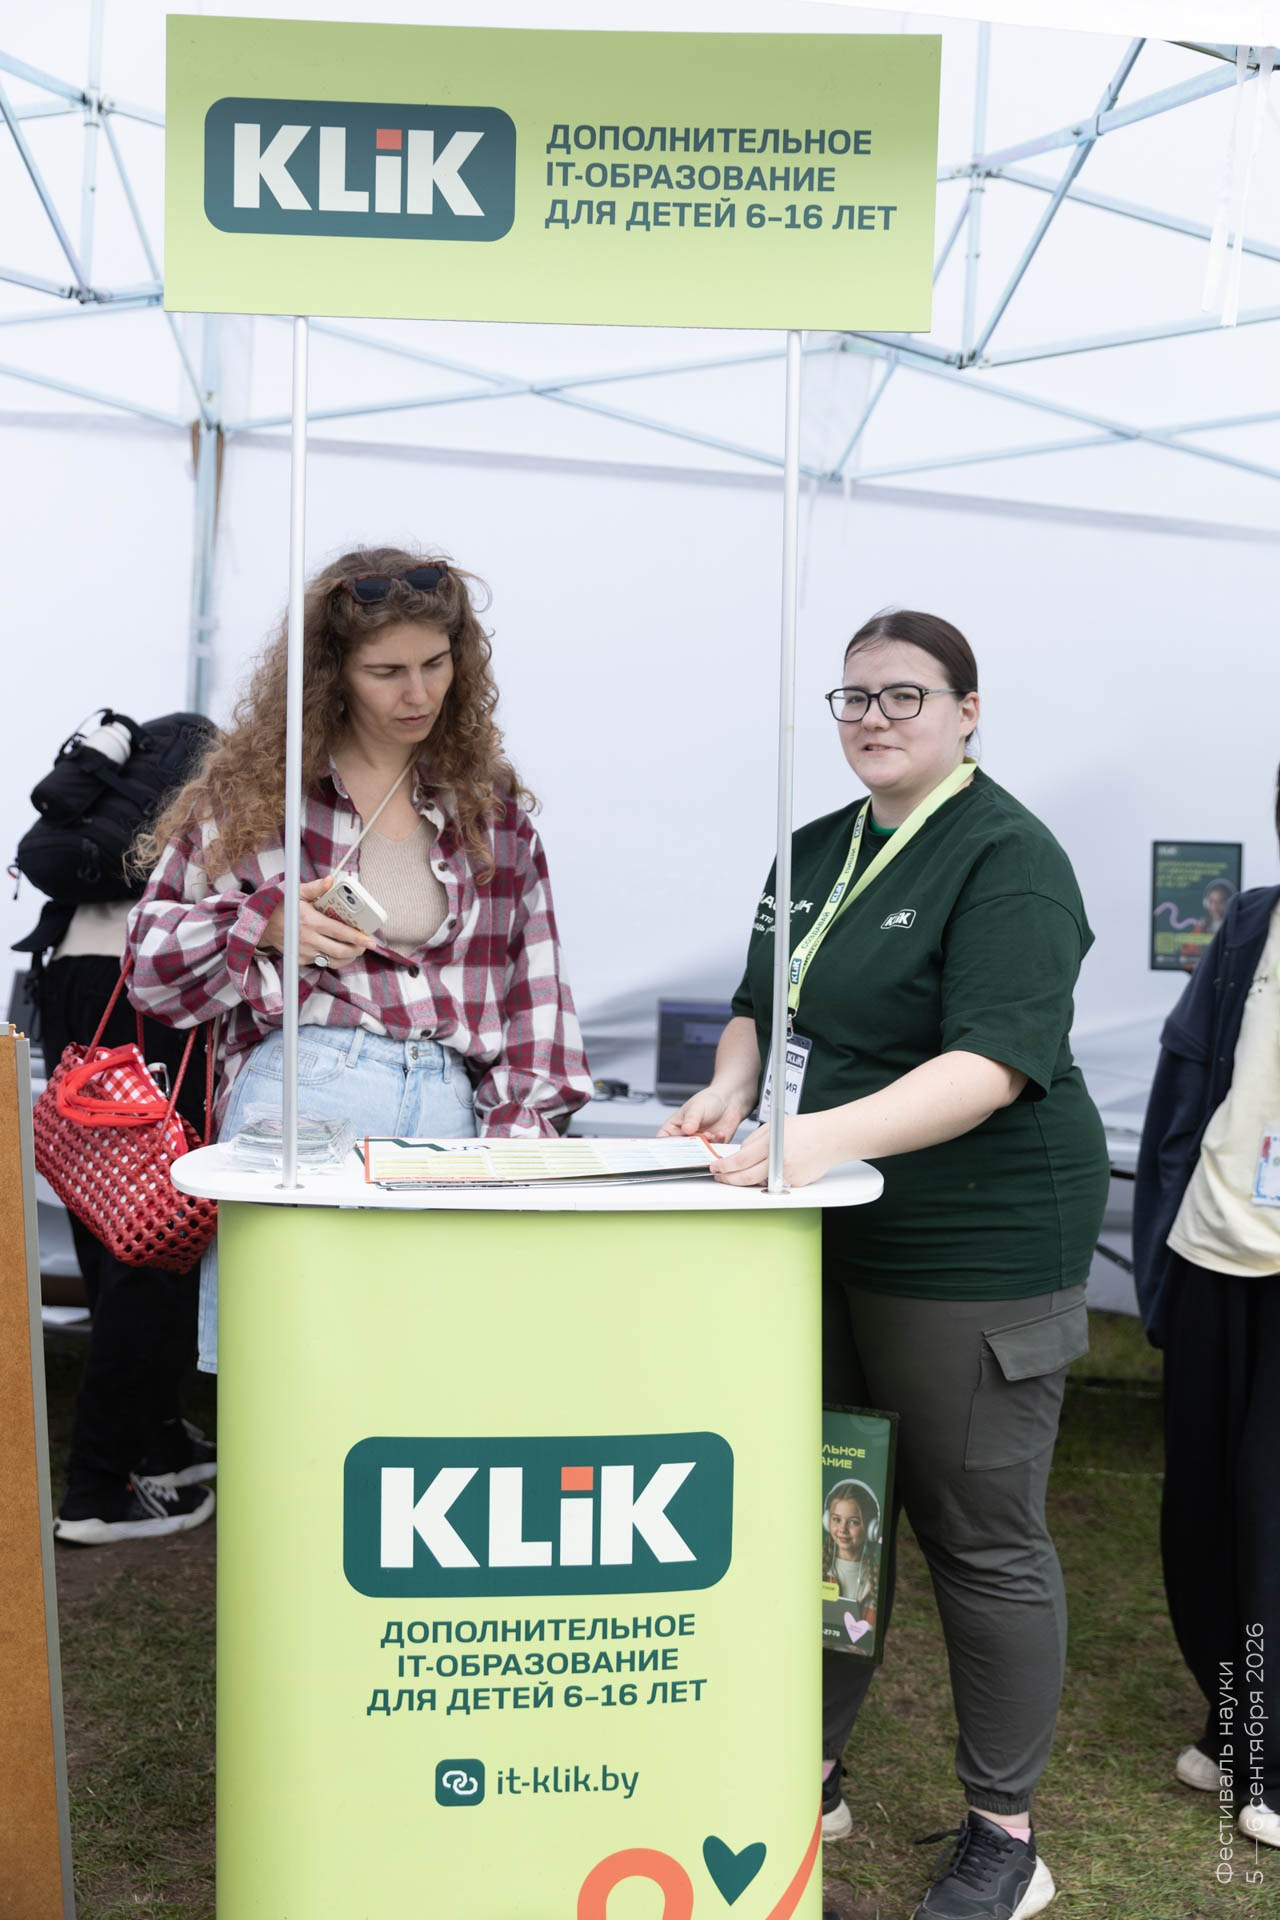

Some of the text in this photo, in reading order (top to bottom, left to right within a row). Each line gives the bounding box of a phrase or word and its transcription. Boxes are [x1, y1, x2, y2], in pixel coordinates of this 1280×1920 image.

[546, 124, 872, 155] ДОПОЛНИТЕЛЬНОЕ
[232, 122, 485, 218] KLiK
[546, 161, 836, 192] IT-ОБРАЗОВАНИЕ
[545, 197, 898, 232] ДЛЯ ДЕТЕЙ 6–16 ЛЕТ
[791, 959, 802, 983] KLiK
[380, 1462, 697, 1568] KLiK
[380, 1613, 696, 1648] ДОПОЛНИТЕЛЬНОЕ
[398, 1648, 679, 1678] IT-ОБРАЗОВАНИЕ
[366, 1678, 708, 1717] ДЛЯ ДЕТЕЙ 6–16 ЛЕТ
[496, 1764, 640, 1799] it-klik.by
